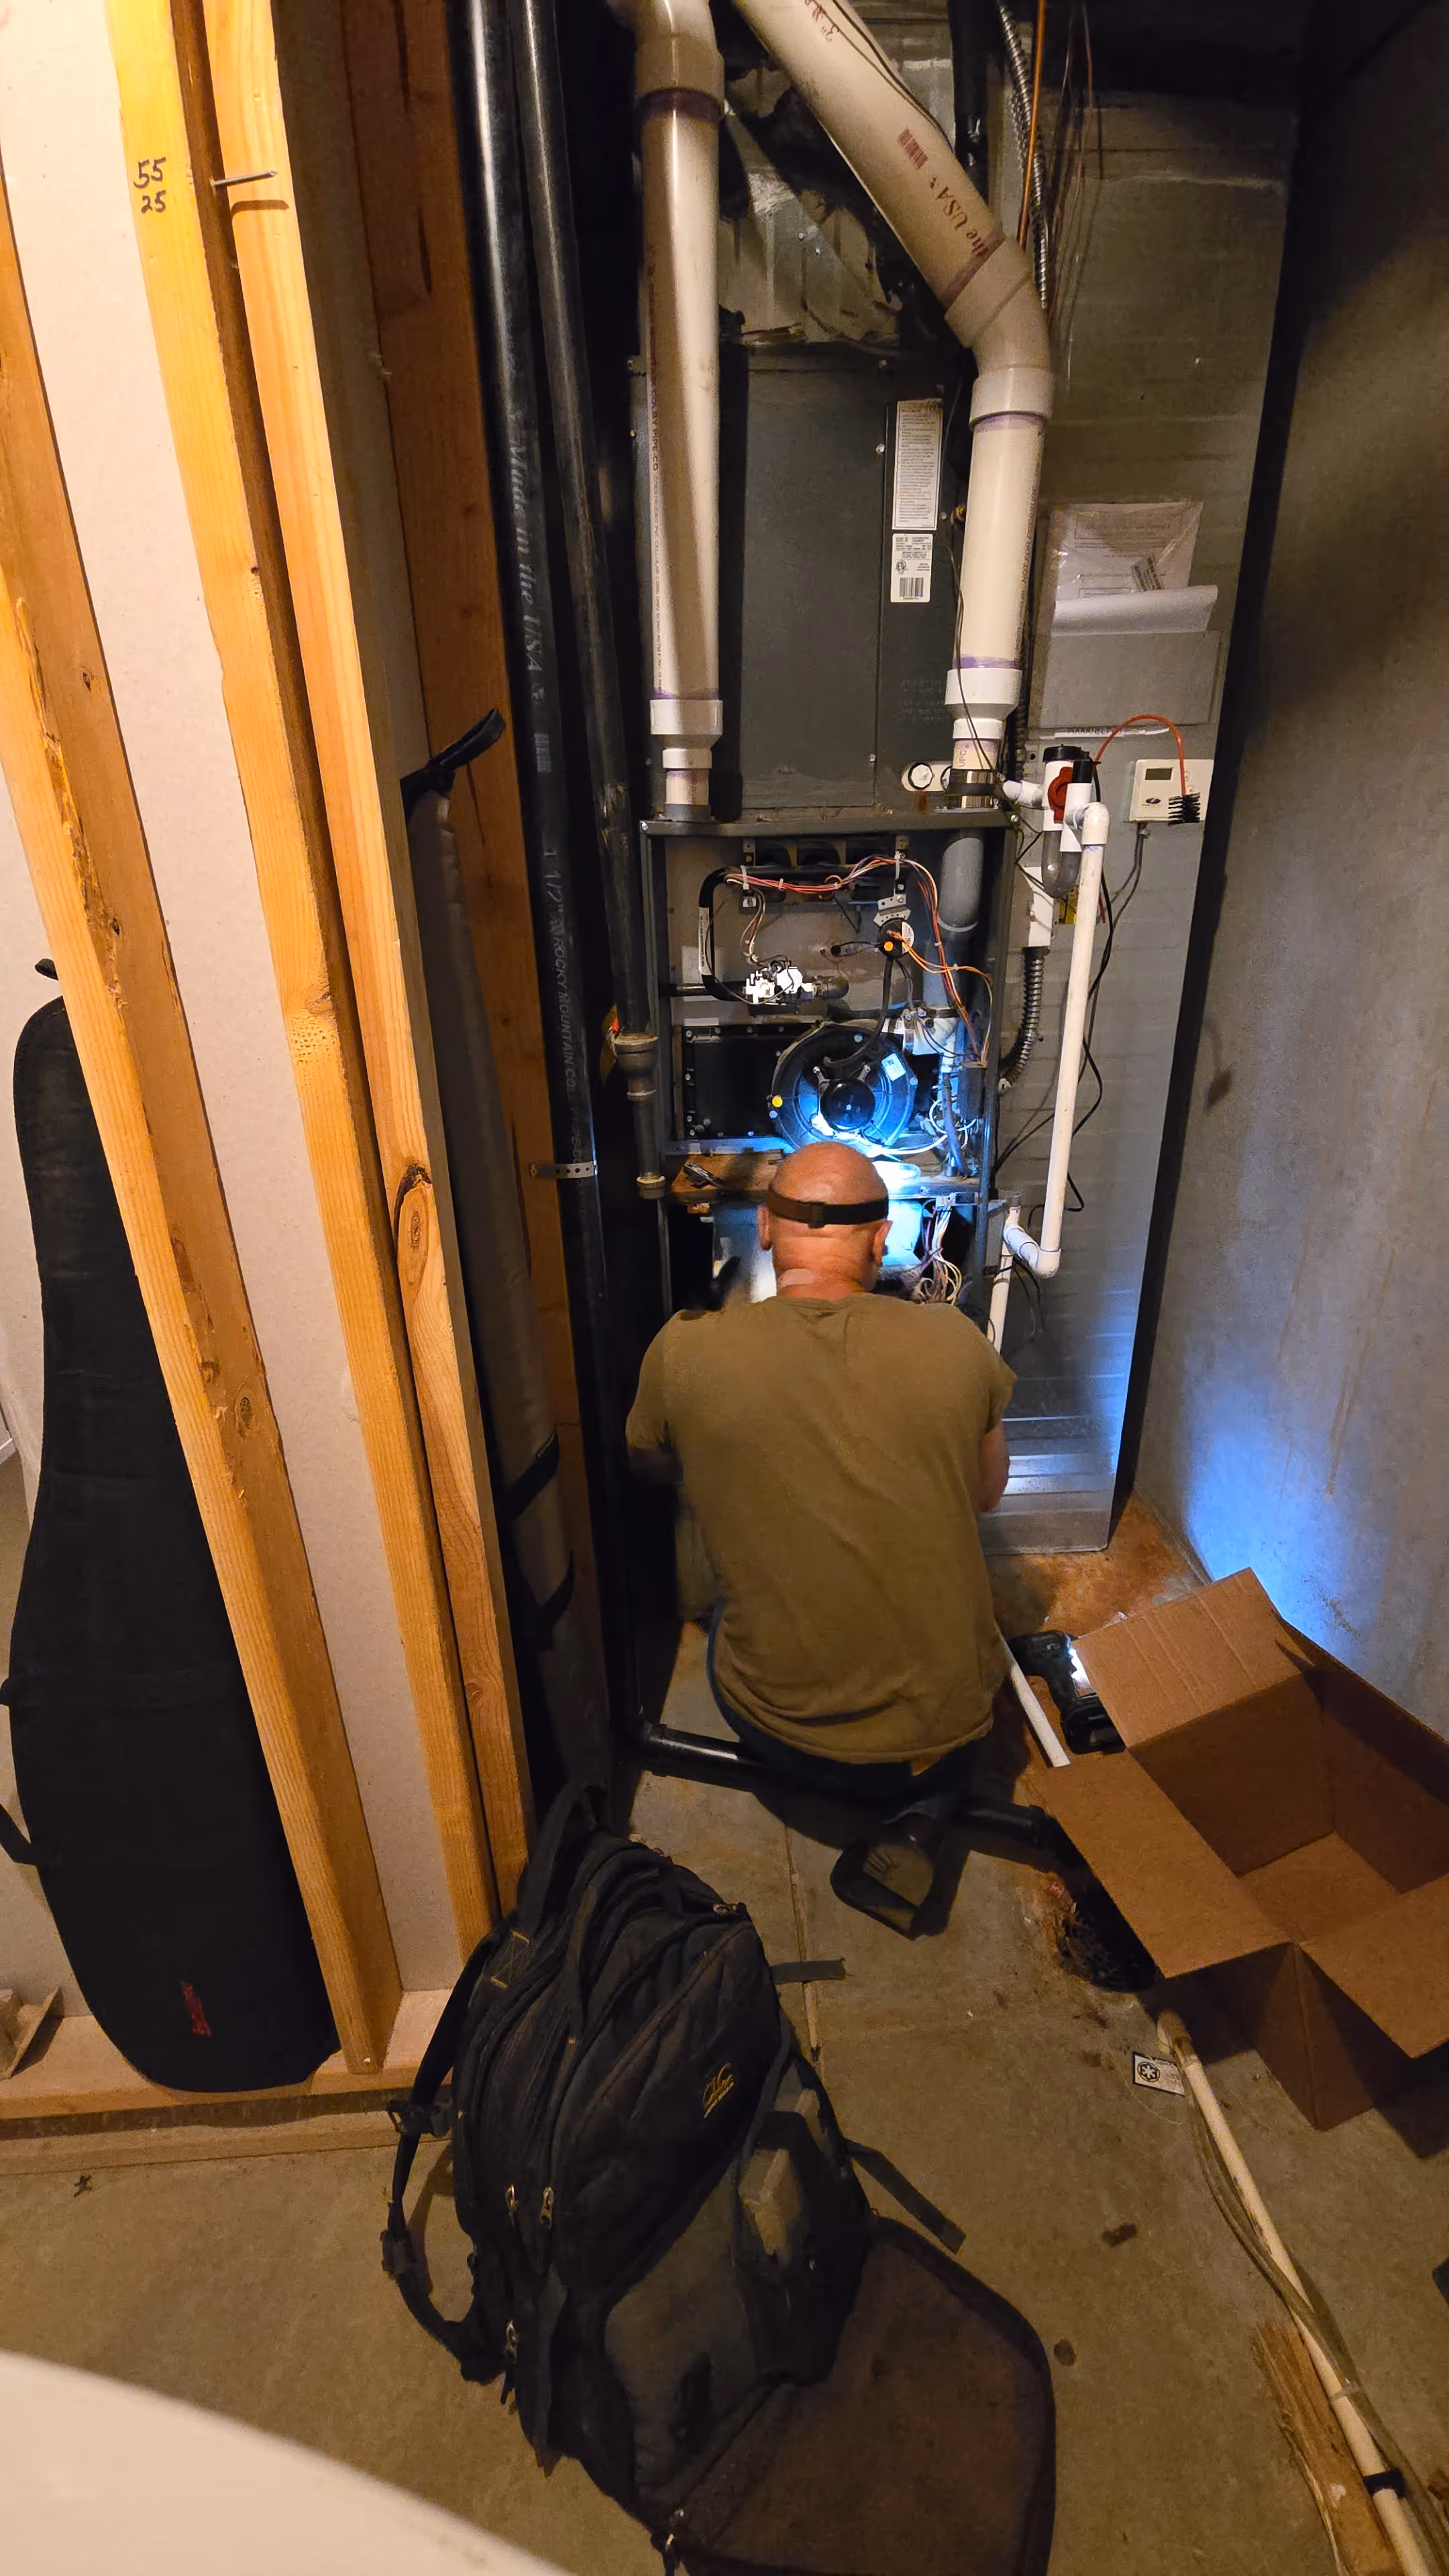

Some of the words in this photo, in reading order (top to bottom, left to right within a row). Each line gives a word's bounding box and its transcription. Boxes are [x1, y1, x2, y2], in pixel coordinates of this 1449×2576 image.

[133, 156, 166, 189] 55
[141, 190, 166, 214] 25
[936, 185, 967, 231] USA
[509, 439, 528, 519] Made
[517, 527, 530, 553] in
[519, 563, 537, 604] the
[523, 614, 544, 672] USA
[553, 936, 569, 990] ROCKY
[557, 990, 574, 1065] MOUNTAIN
